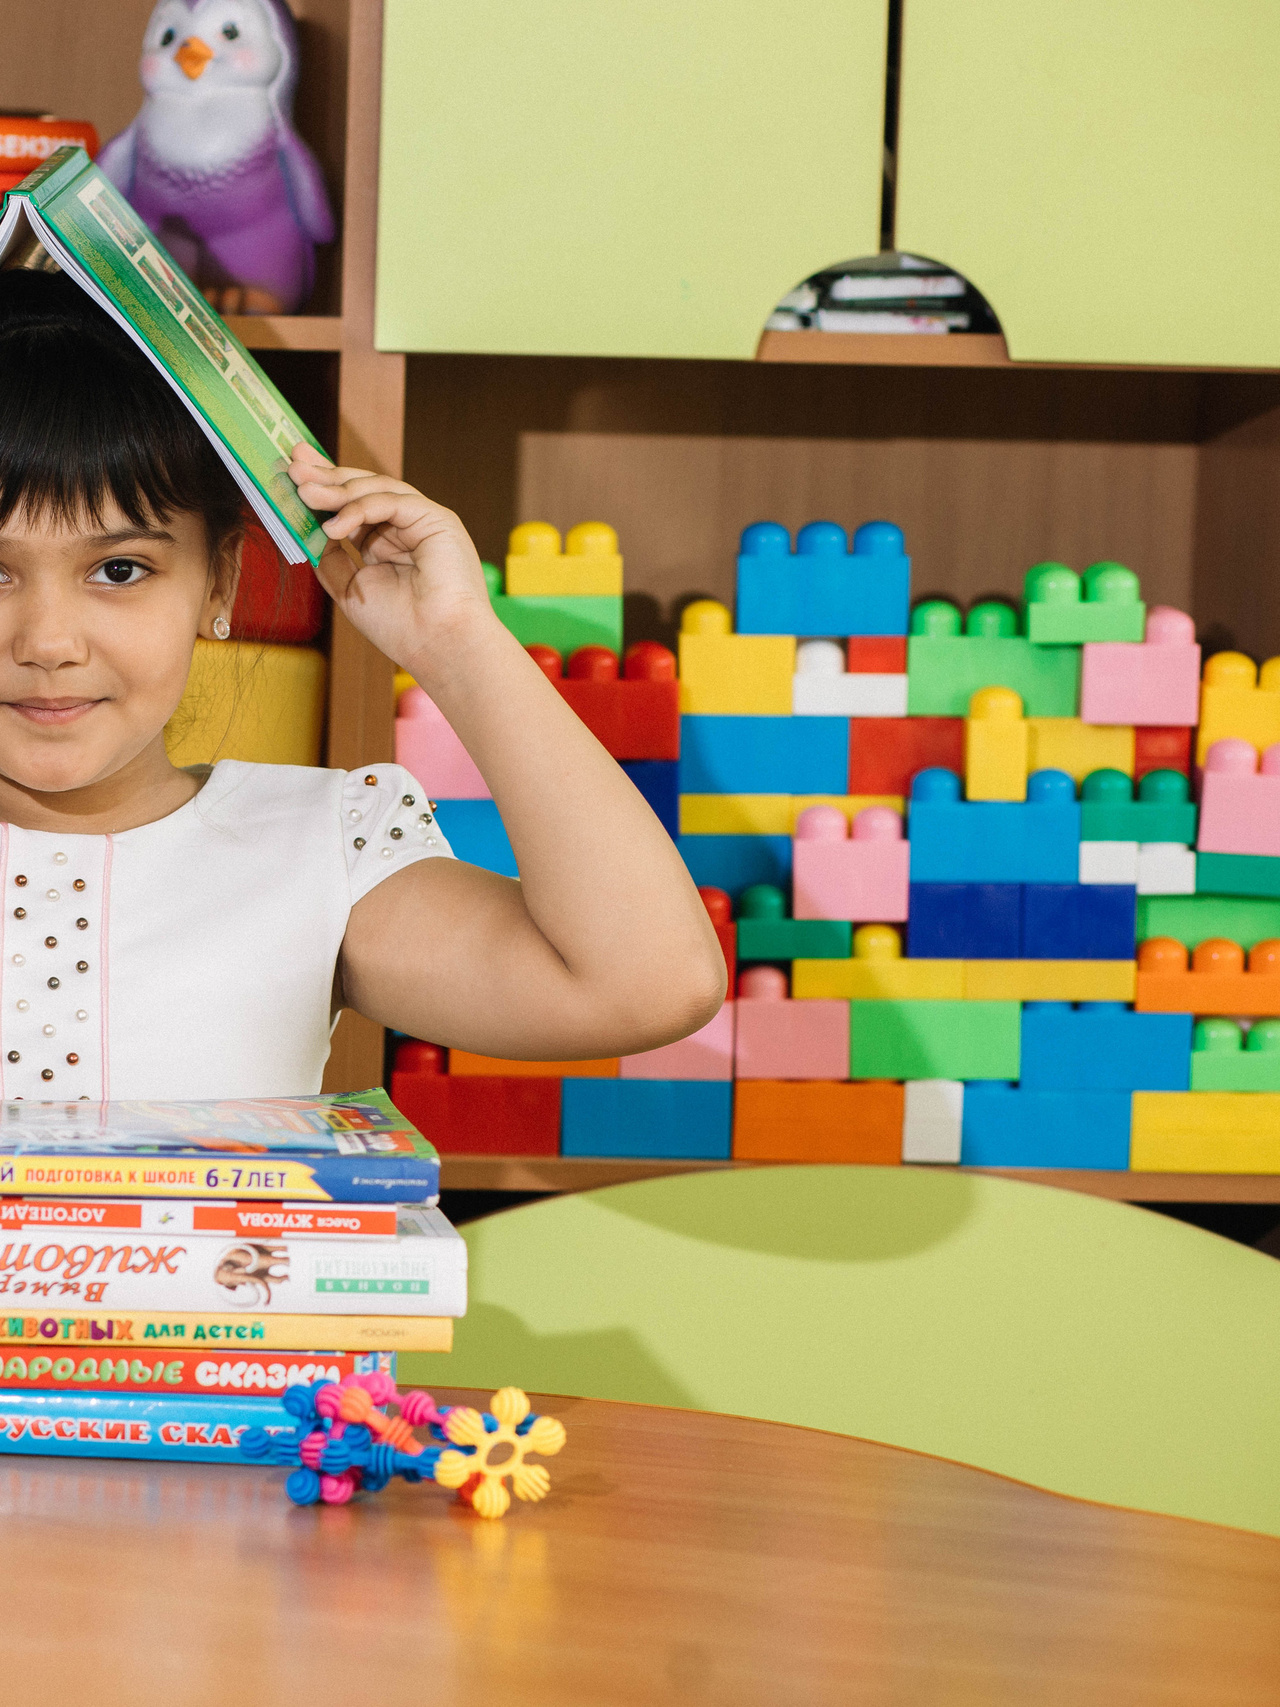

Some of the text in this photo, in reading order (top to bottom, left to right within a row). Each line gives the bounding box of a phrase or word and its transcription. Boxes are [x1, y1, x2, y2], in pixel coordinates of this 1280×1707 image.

[25, 1168, 122, 1184] ПОДГОТОВКА
[128, 1169, 138, 1184] К
[143, 1170, 196, 1185] ШКОЛЕ
[205, 1168, 243, 1188] 6-7
[246, 1171, 287, 1188] ЛЕТ
[237, 1211, 362, 1231] Олеся ЖУКОВА
[194, 1360, 341, 1389] СКАЗКИ
